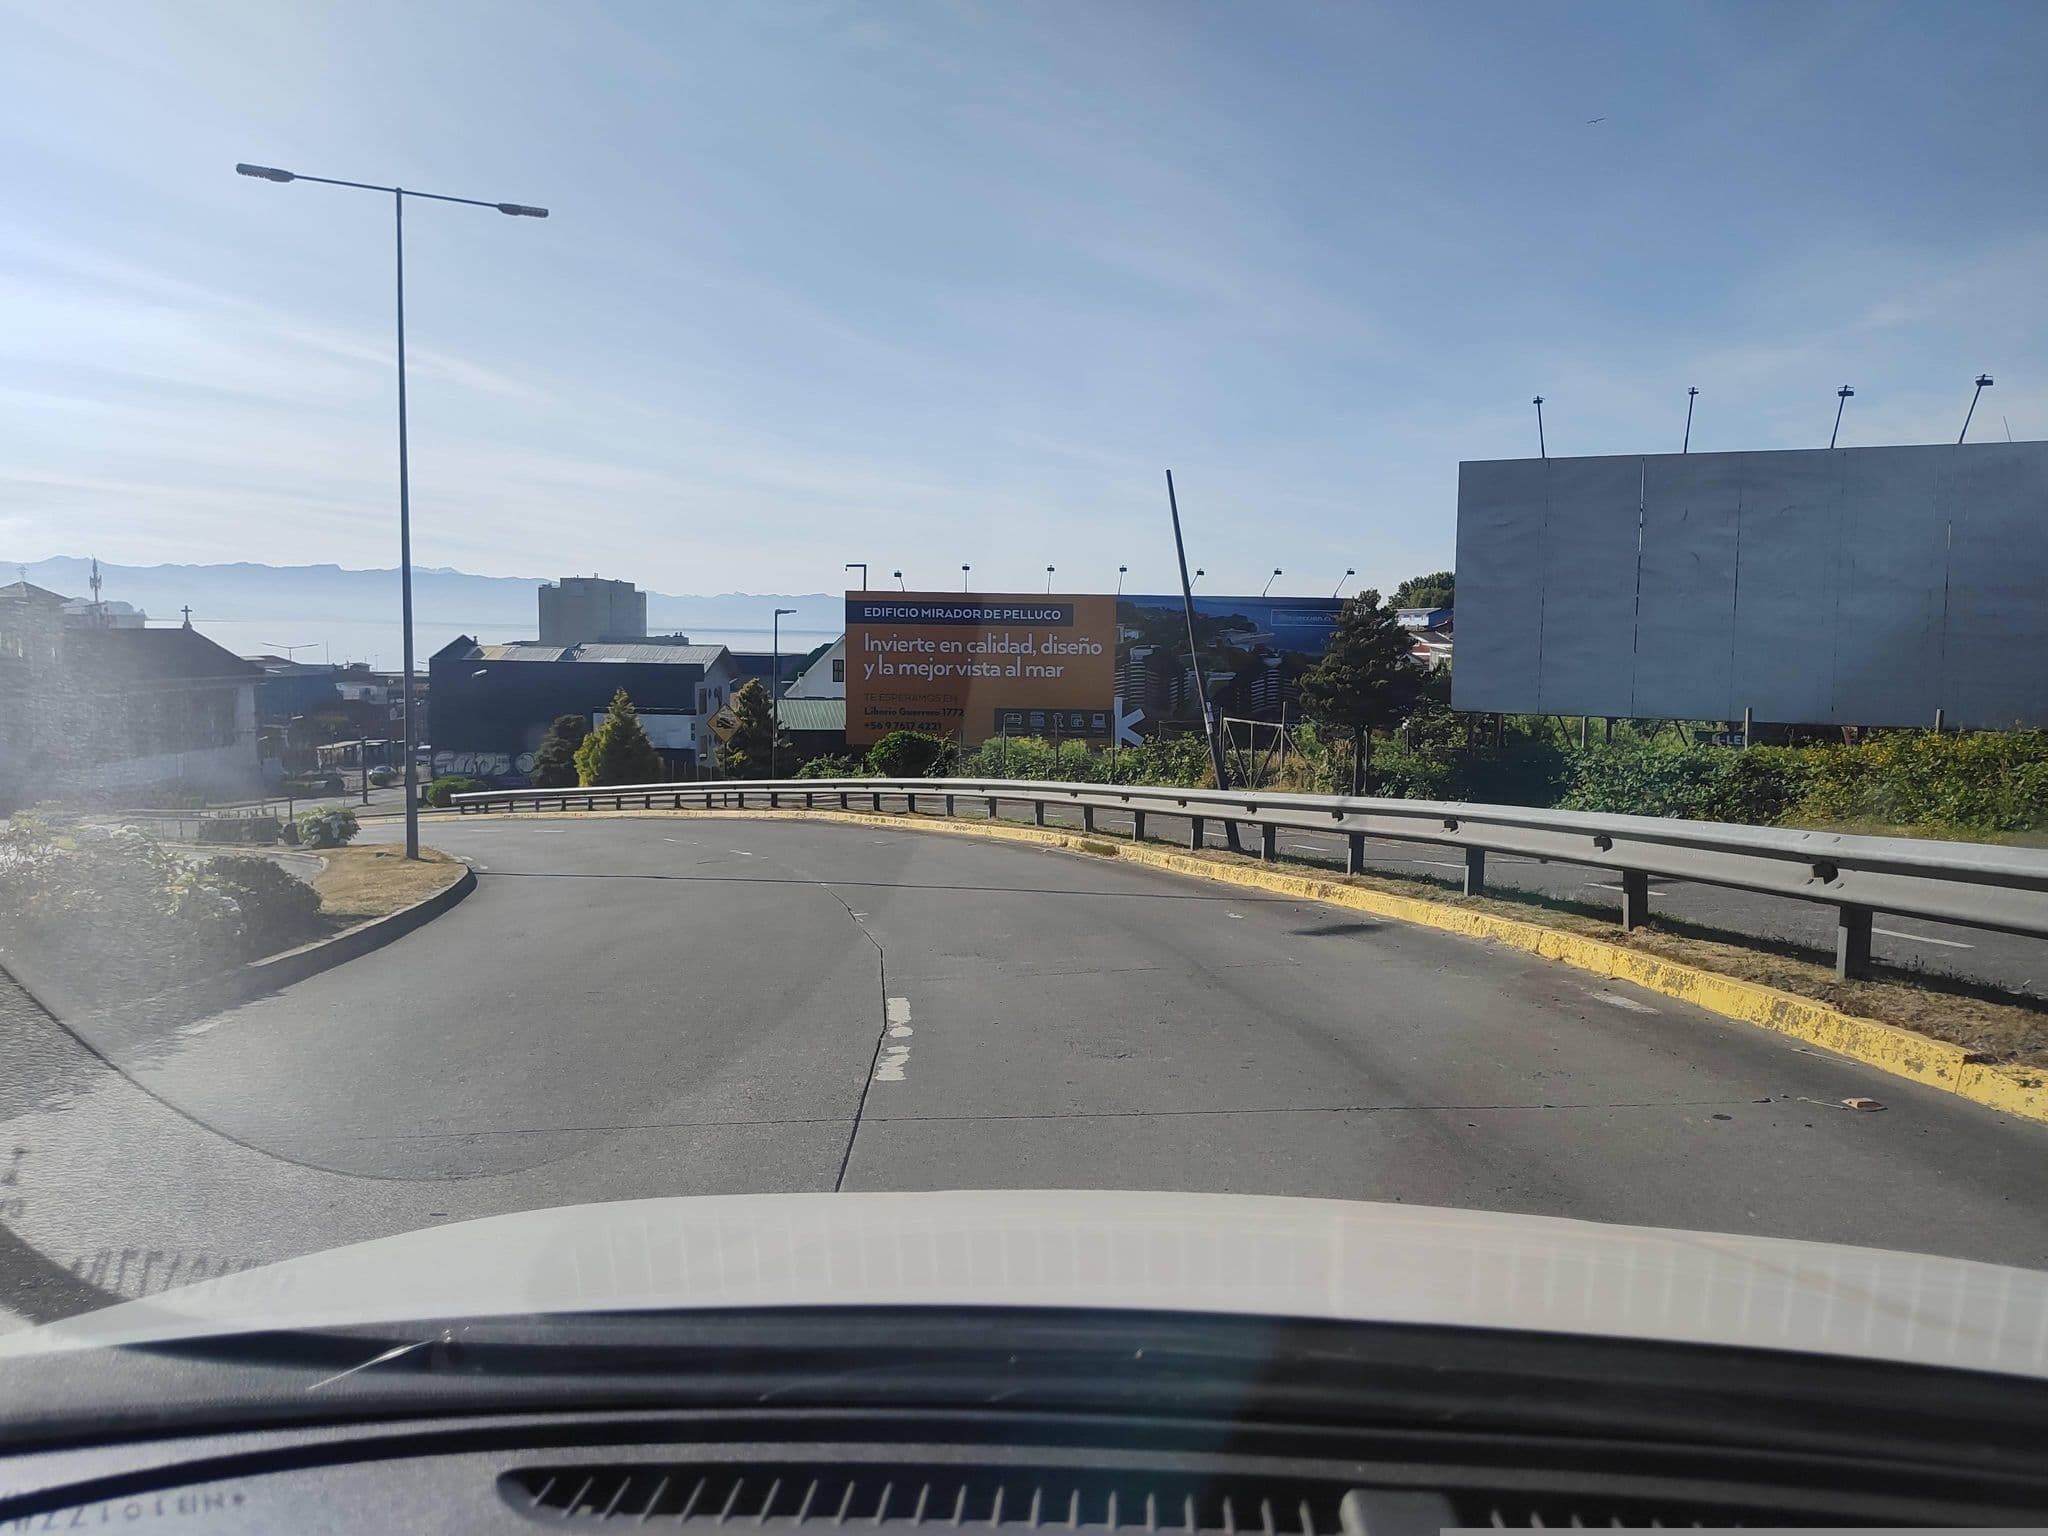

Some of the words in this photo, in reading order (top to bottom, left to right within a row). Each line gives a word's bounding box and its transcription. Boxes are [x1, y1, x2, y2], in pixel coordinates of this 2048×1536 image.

[864, 607, 919, 618] EDIFICIO
[921, 608, 981, 619] MIRADOR
[983, 609, 1001, 620] DE
[1003, 609, 1062, 620] PELLUCO
[864, 632, 935, 653] Invierte
[939, 639, 962, 653] en
[966, 633, 1036, 656] calidad,
[1040, 634, 1103, 655] diseño
[864, 661, 876, 680] y
[878, 655, 894, 675] la
[899, 658, 954, 681] mejor
[956, 658, 1001, 677] vista
[1005, 656, 1021, 677] al
[1025, 664, 1065, 678] mar
[942, 708, 965, 717] 1772
